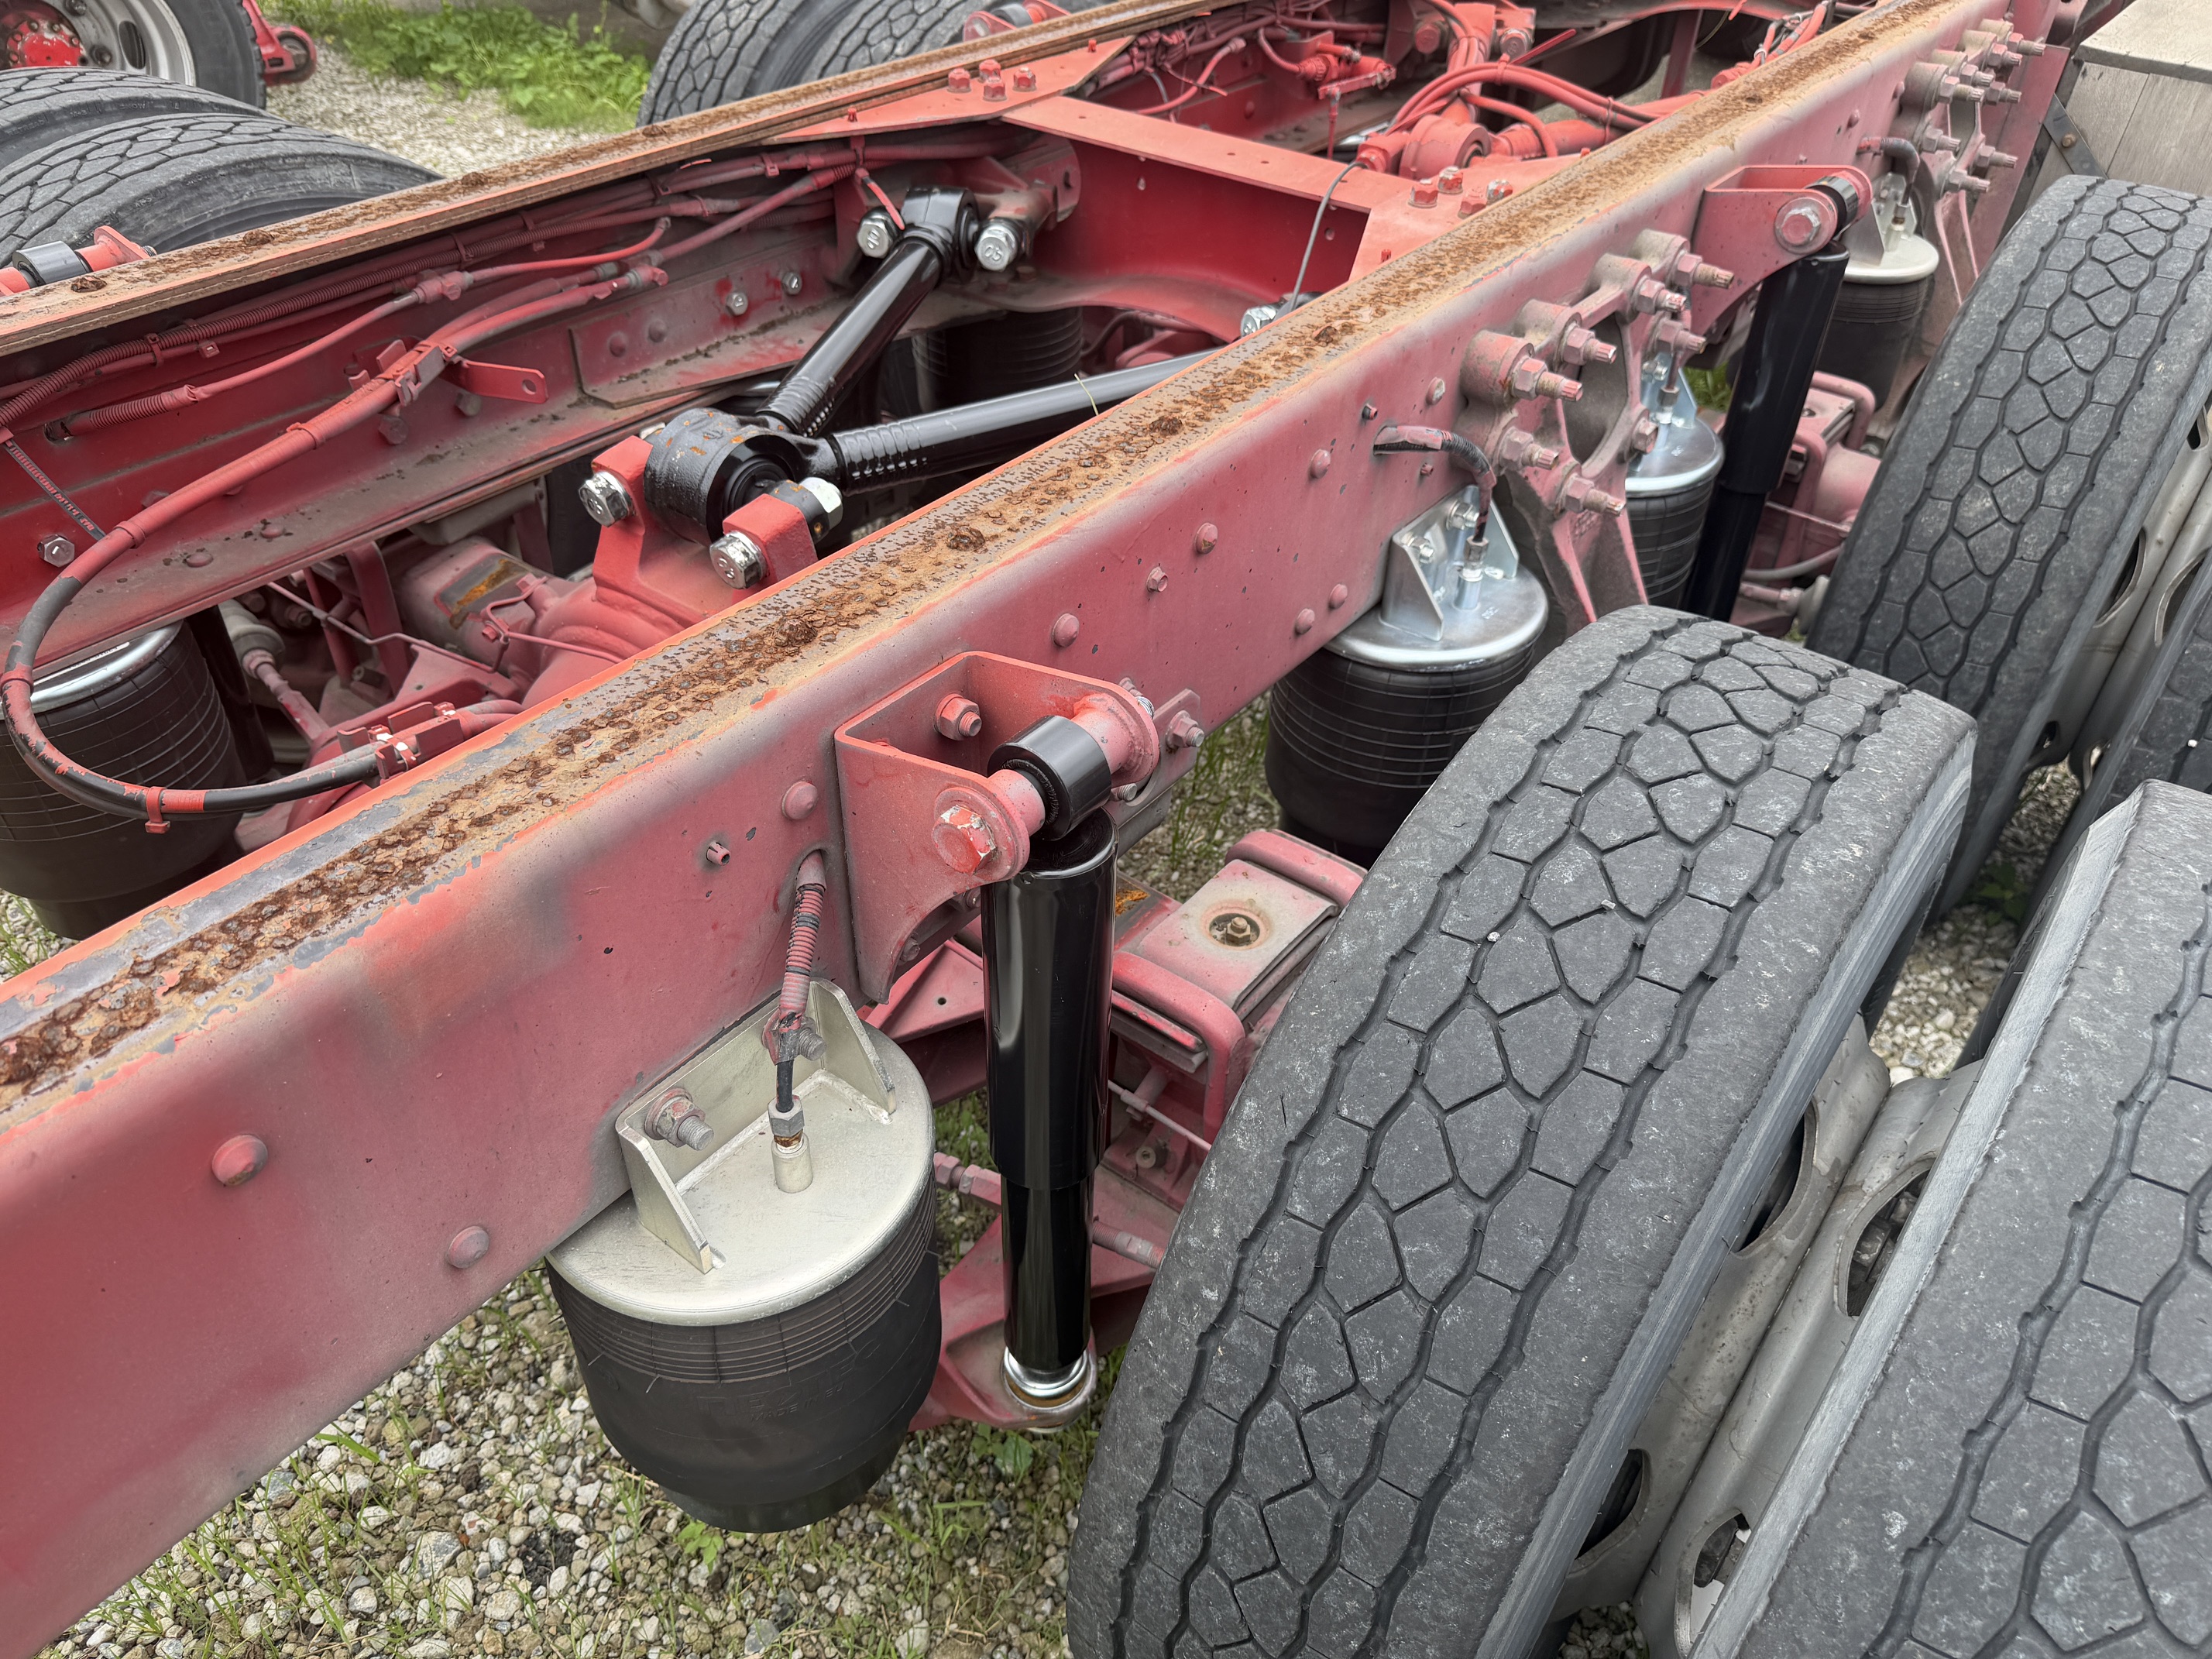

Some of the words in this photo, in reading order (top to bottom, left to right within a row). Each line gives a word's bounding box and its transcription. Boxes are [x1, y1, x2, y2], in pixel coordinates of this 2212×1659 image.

[751, 1403, 799, 1422] MADE
[805, 1396, 819, 1408] IN
[825, 1382, 845, 1398] EU
